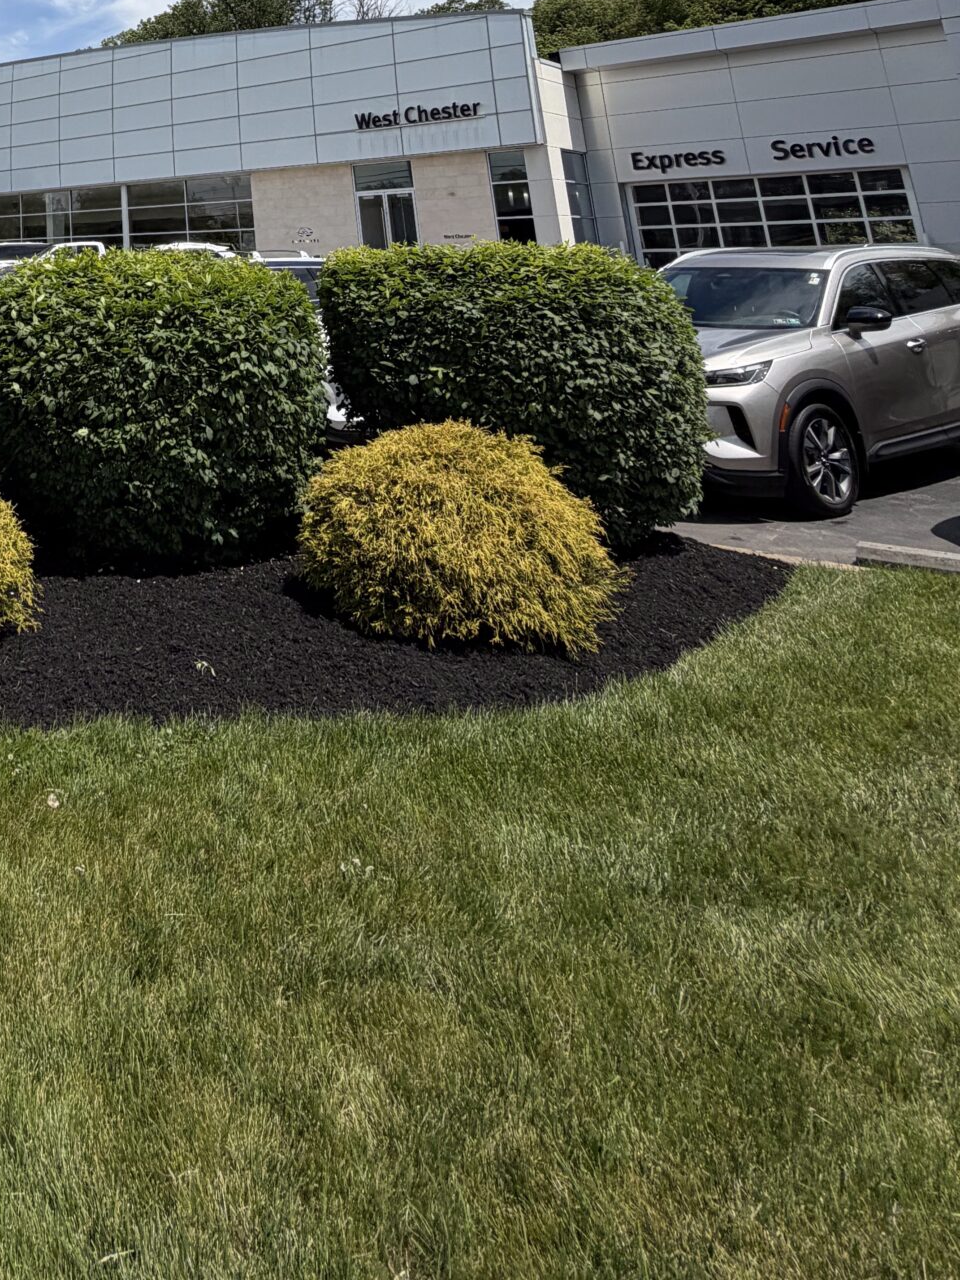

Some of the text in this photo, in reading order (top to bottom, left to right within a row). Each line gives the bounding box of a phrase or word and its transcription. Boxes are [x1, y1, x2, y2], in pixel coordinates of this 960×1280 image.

[354, 101, 481, 130] West Chester
[630, 135, 876, 174] Express Service
